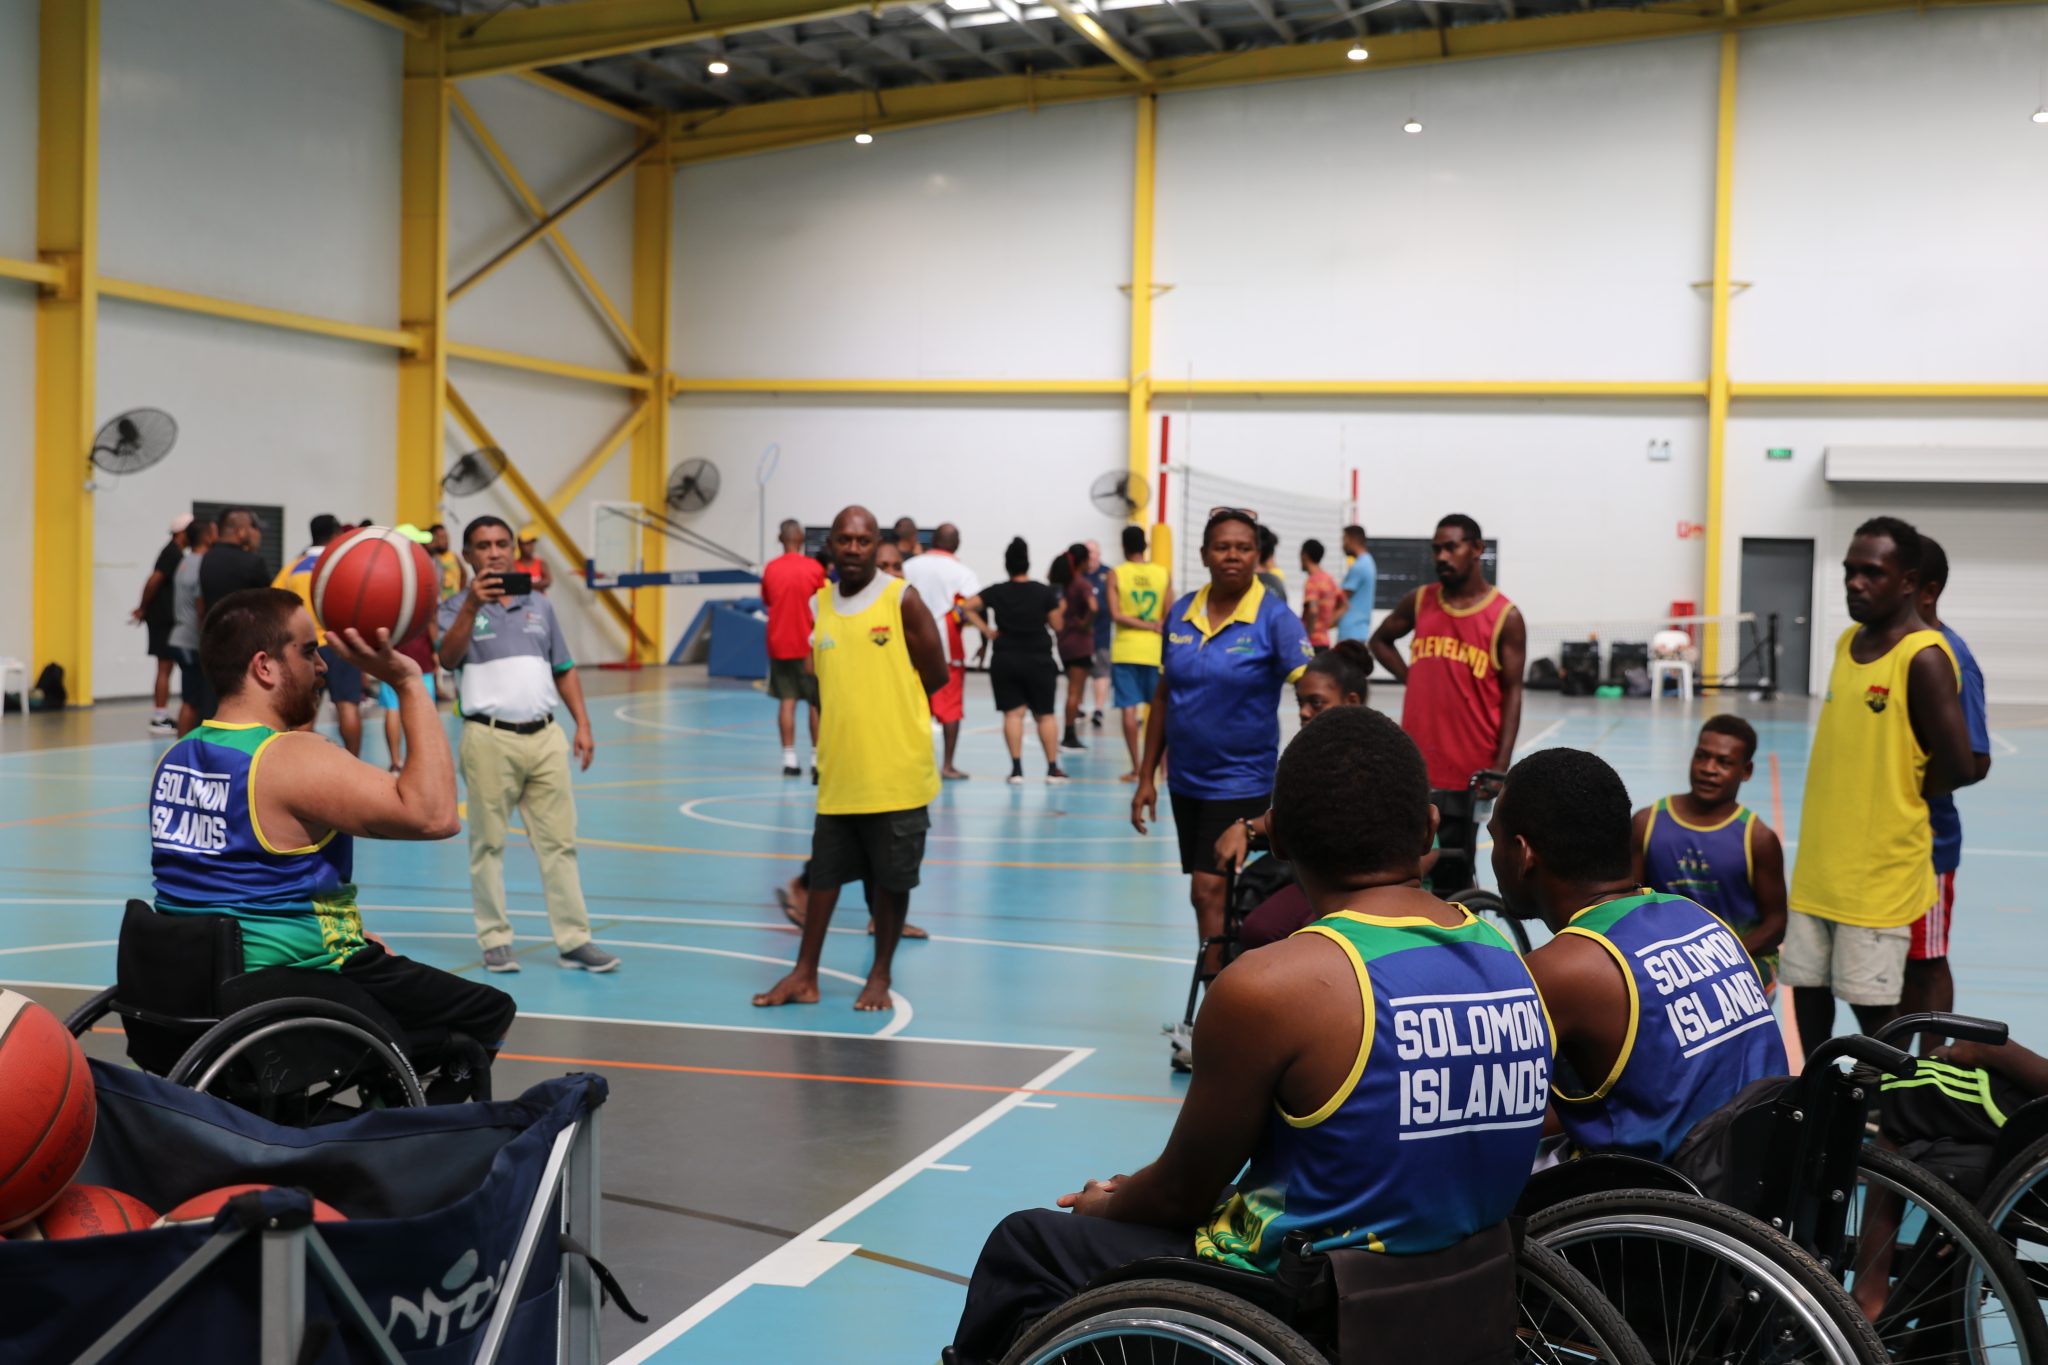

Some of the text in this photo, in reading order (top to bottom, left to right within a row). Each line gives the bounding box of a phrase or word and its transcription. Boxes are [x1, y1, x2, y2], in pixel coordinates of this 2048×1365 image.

[155, 772, 230, 812] SOLOMON
[1644, 931, 1745, 996] SOLOMON
[1394, 1000, 1545, 1060] SOLOMON
[1666, 968, 1767, 1047] ISLANDS
[1400, 1058, 1548, 1125] ISLANDS
